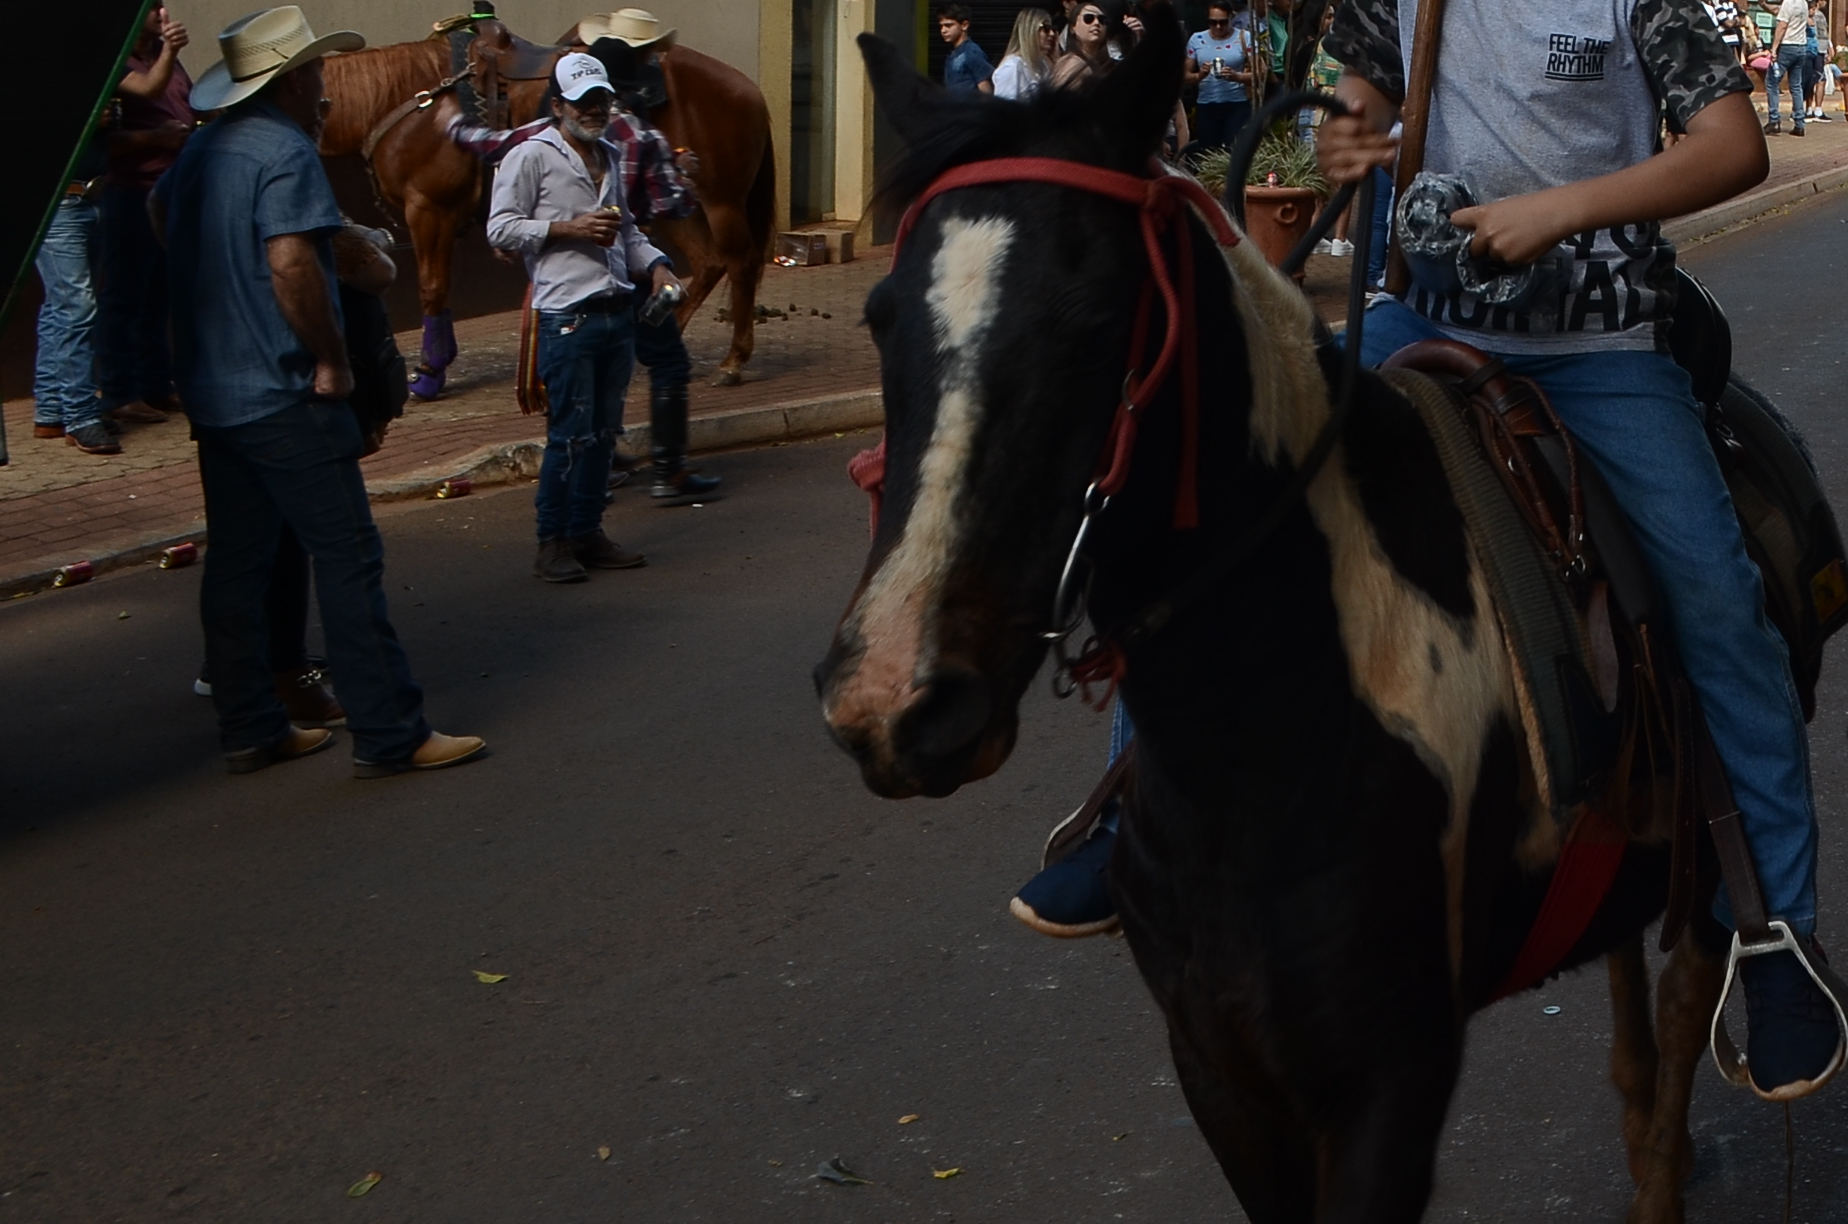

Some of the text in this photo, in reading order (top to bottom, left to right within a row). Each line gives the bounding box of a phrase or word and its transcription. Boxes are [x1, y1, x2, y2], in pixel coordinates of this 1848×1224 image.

[1549, 33, 1611, 55] FEEL THE
[1546, 52, 1605, 74] RHYTHM
